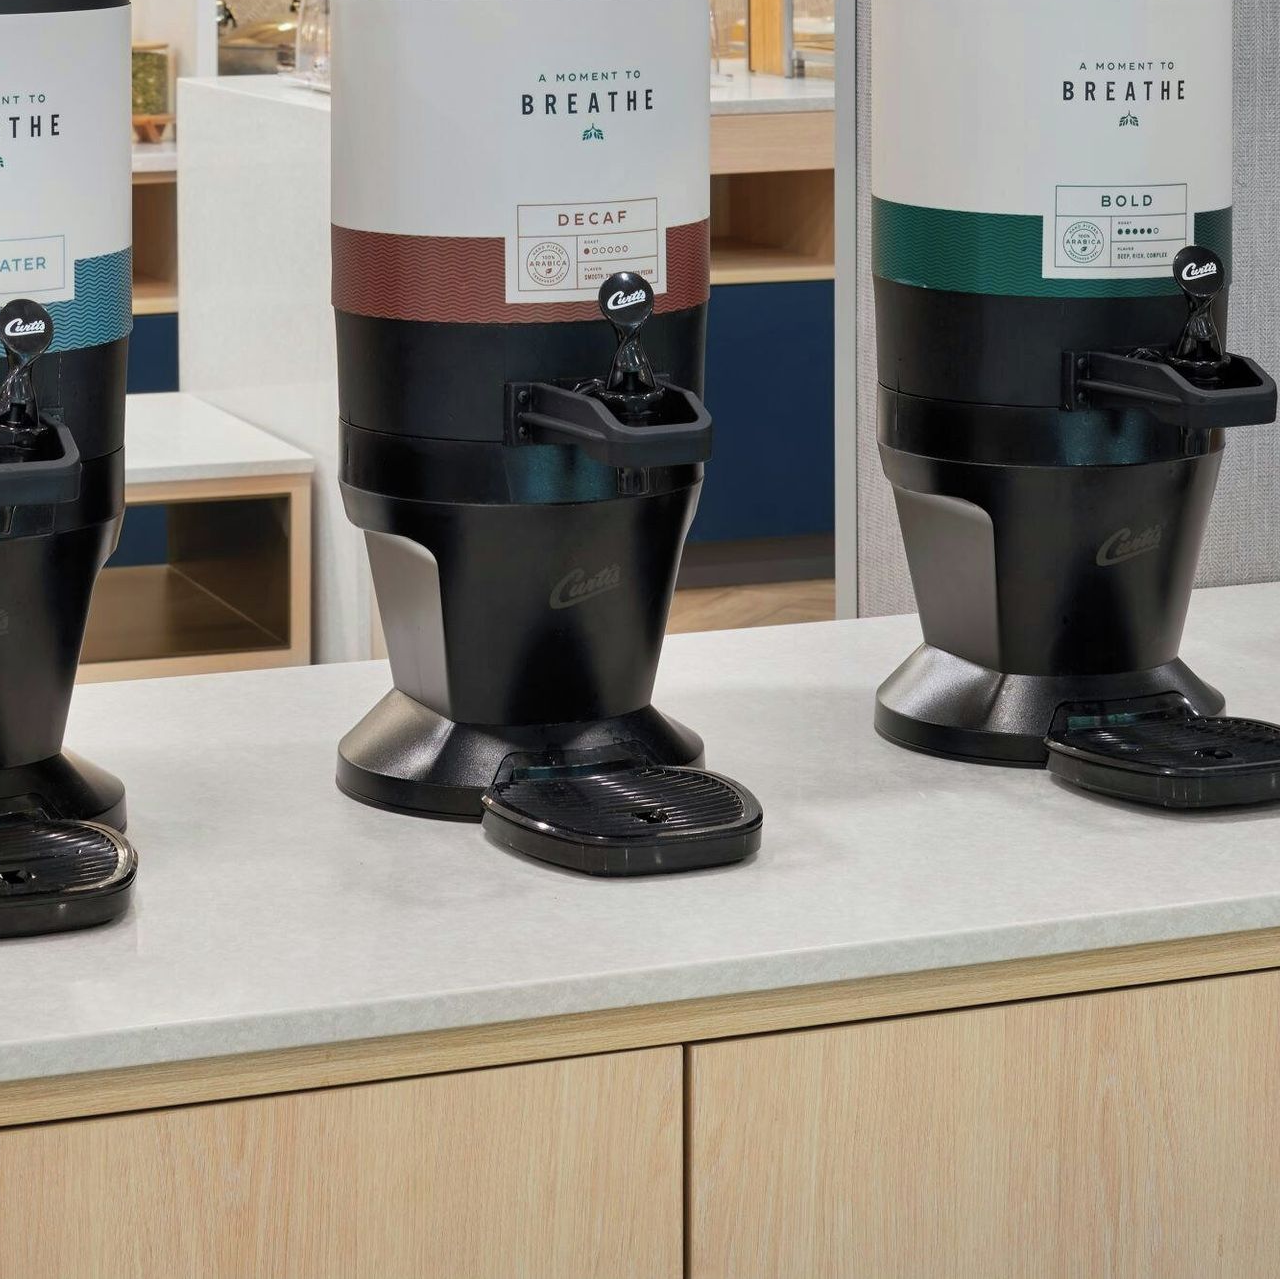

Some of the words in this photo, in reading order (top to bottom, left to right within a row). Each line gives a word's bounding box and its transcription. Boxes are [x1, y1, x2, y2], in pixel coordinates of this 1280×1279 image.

[1079, 62, 1087, 71] A
[1095, 62, 1154, 71] MOMENT
[1160, 61, 1175, 71] TO
[537, 73, 547, 83] A
[555, 71, 618, 83] MOMENT
[625, 69, 641, 80] TO
[28, 93, 46, 104] TO
[1062, 79, 1185, 102] BREATHE
[521, 88, 653, 116] BREATHE
[1100, 194, 1154, 208] BOLD
[557, 210, 628, 227] DECAF
[1181, 262, 1218, 281] Curtis
[607, 289, 646, 310] Curtis
[4, 318, 46, 337] Curtis
[1095, 524, 1162, 567] Curtis
[549, 564, 623, 610] Curtis
